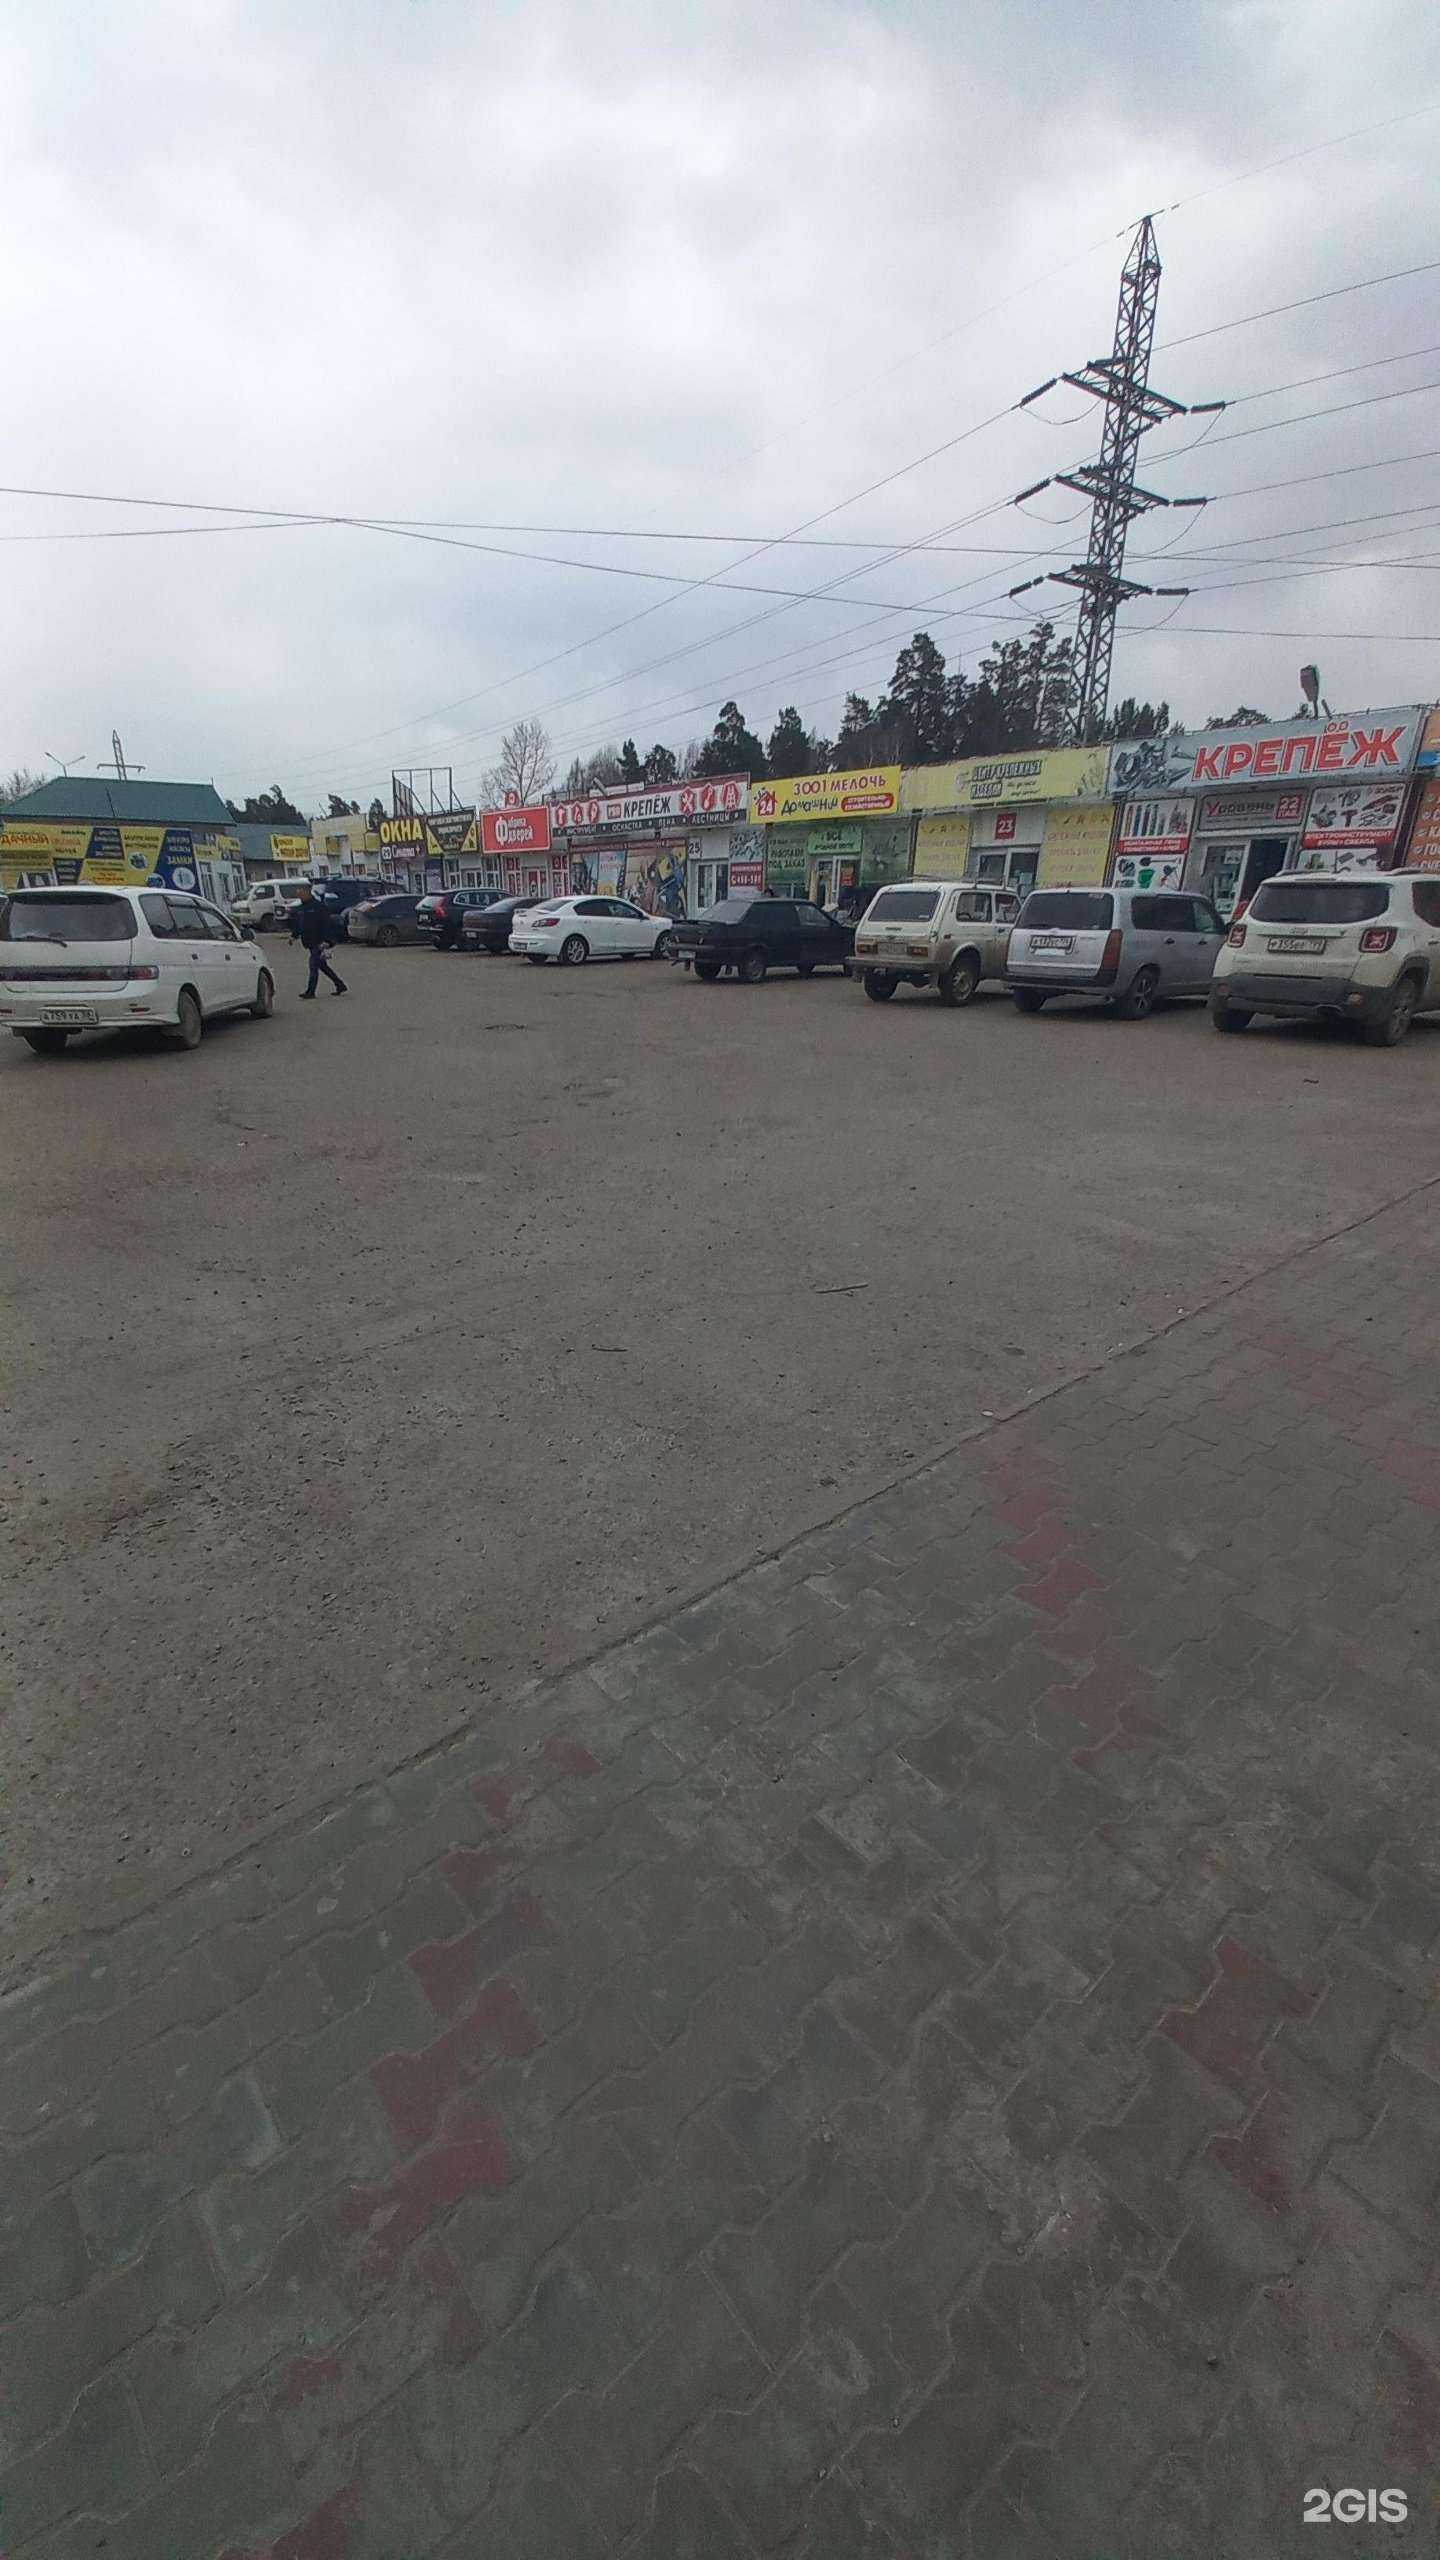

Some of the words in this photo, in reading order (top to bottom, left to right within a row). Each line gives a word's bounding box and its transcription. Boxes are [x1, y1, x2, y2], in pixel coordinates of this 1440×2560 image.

[1192, 721, 1407, 781] КРЕПЁЖ
[794, 780, 827, 796] 3001
[830, 775, 886, 792] МЕЛОЧЬ
[623, 796, 671, 818] КРЕПЁЖ
[759, 801, 773, 814] 24
[1280, 797, 1299, 809] 22
[380, 818, 424, 844] ОКНА
[612, 822, 643, 832] ОСНАСТКА
[658, 818, 676, 827] ПЕНА
[692, 813, 730, 824] ЛЕСТНИЦЫ
[998, 819, 1014, 834] 23
[688, 842, 700, 853] 25
